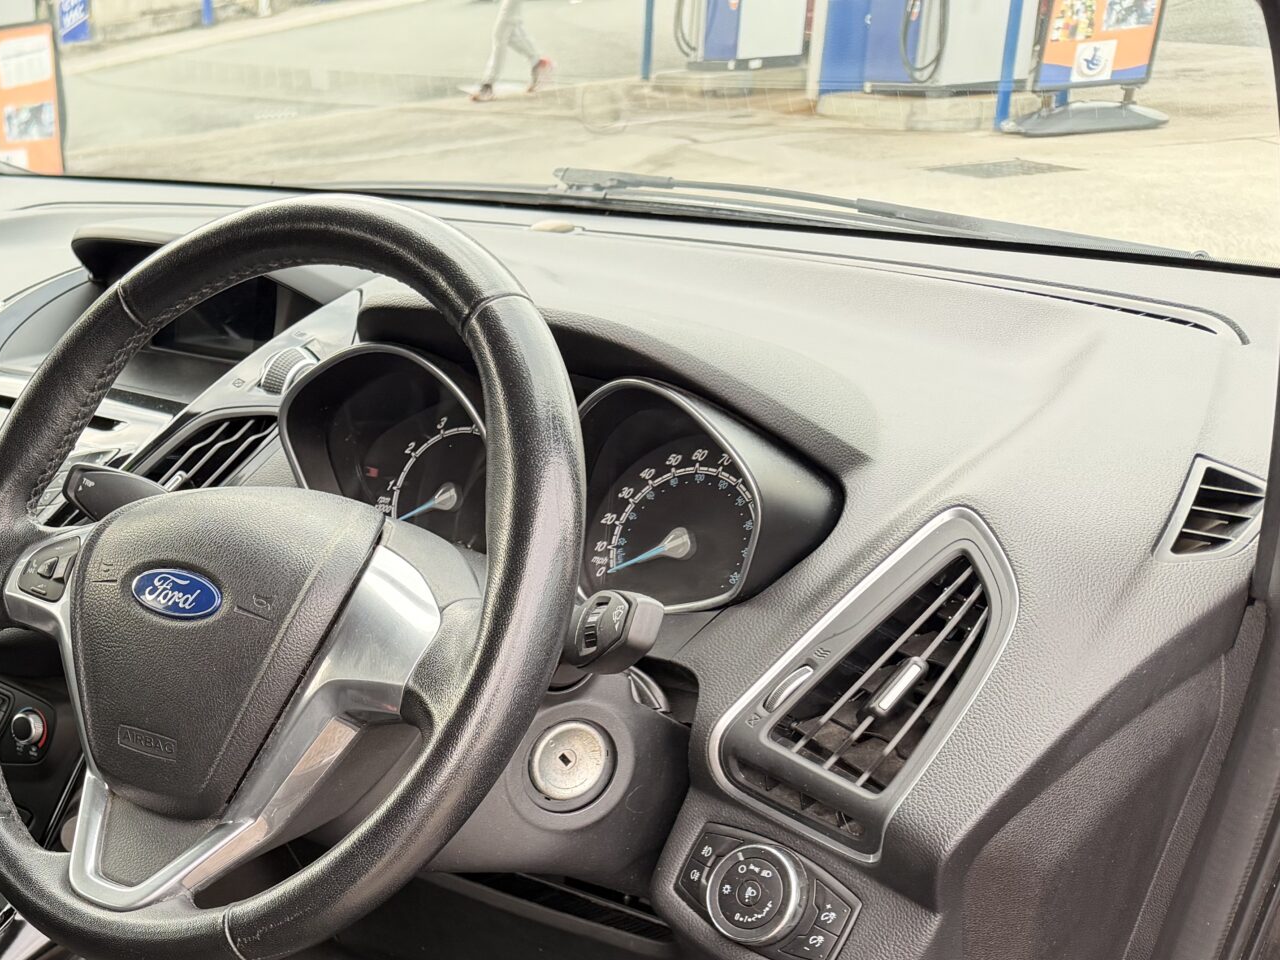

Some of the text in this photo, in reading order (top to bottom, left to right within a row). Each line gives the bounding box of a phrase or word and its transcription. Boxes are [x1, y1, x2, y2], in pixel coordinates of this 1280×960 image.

[437, 416, 448, 429] 3
[404, 442, 416, 454] 2
[666, 454, 683, 466] 50
[691, 449, 709, 461] 60
[717, 453, 732, 466] 70
[639, 468, 656, 480] 40
[82, 477, 95, 488] TRIP
[387, 479, 396, 491] 1
[618, 487, 634, 499] 30
[600, 512, 617, 525] 20
[594, 541, 607, 552] 10
[591, 556, 608, 567] mph
[596, 566, 606, 577] 0
[145, 573, 201, 610] Ford
[122, 729, 176, 754] AIRBAG
